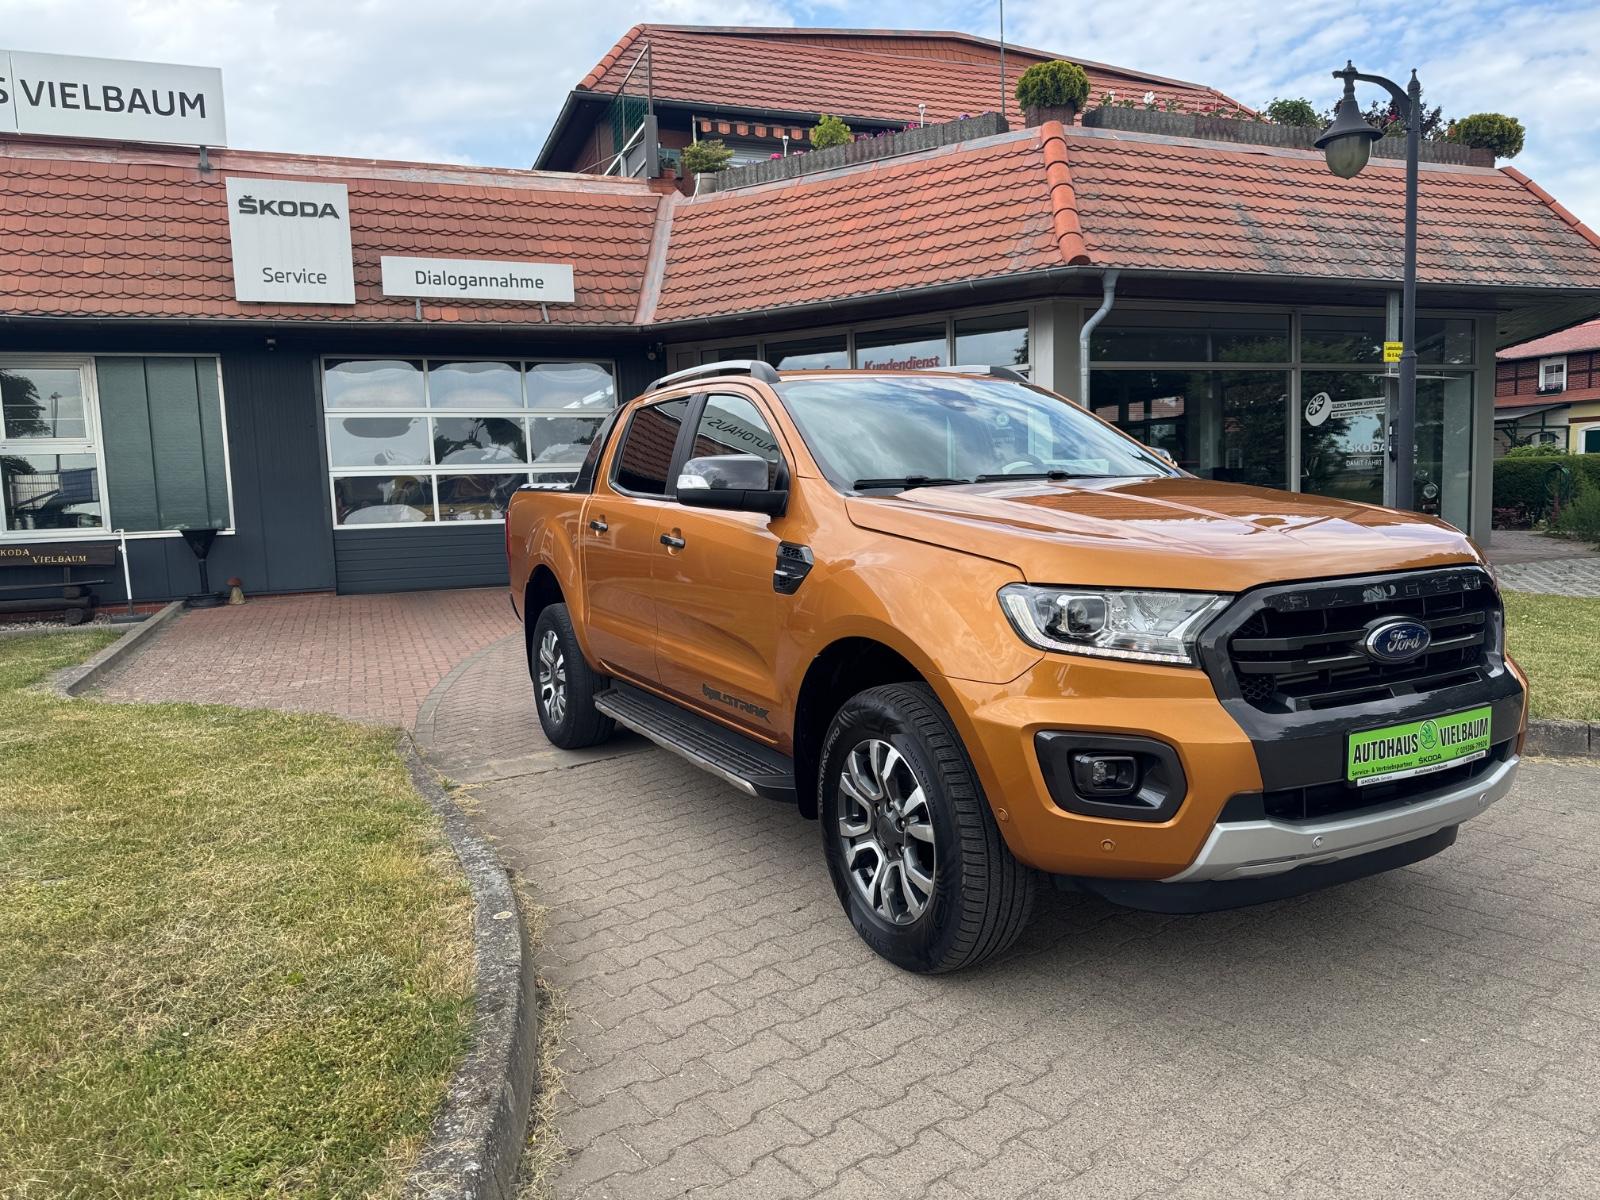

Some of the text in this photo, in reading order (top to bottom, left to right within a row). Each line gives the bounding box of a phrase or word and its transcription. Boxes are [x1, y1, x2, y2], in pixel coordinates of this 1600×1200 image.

[20, 79, 206, 119] VIELBAUM
[238, 195, 340, 219] ŠKODA
[262, 267, 327, 285] Service
[415, 270, 545, 291] Dialogannahme
[864, 356, 939, 370] Kundendienst
[32, 555, 87, 564] VIELBAUM
[1387, 629, 1421, 653] Ford
[1353, 718, 1488, 764] AUTOHAUS VIELBAUM
